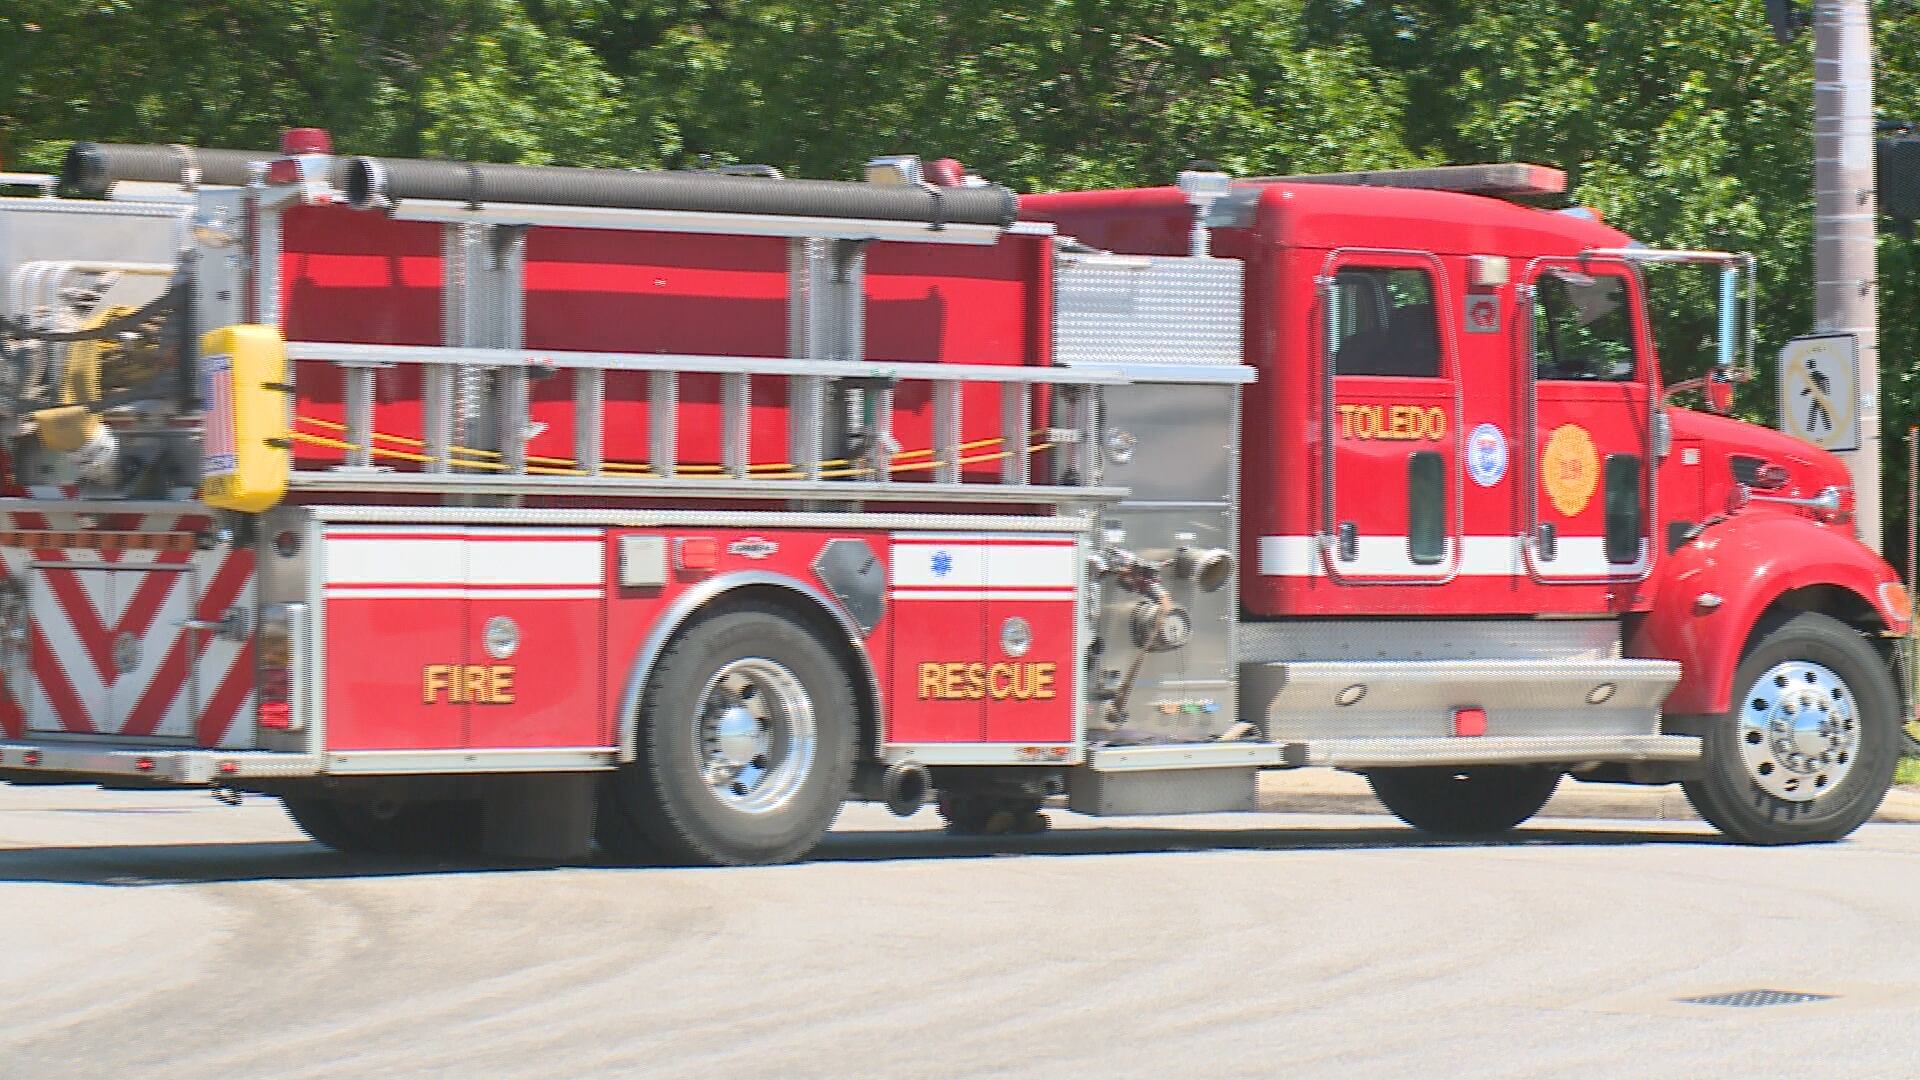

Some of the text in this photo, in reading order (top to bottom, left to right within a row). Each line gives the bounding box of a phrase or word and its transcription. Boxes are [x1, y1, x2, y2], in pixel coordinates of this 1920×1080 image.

[1336, 404, 1447, 440] TOLEDO
[423, 664, 516, 703] FIRE
[917, 662, 1057, 700] RESCUE
